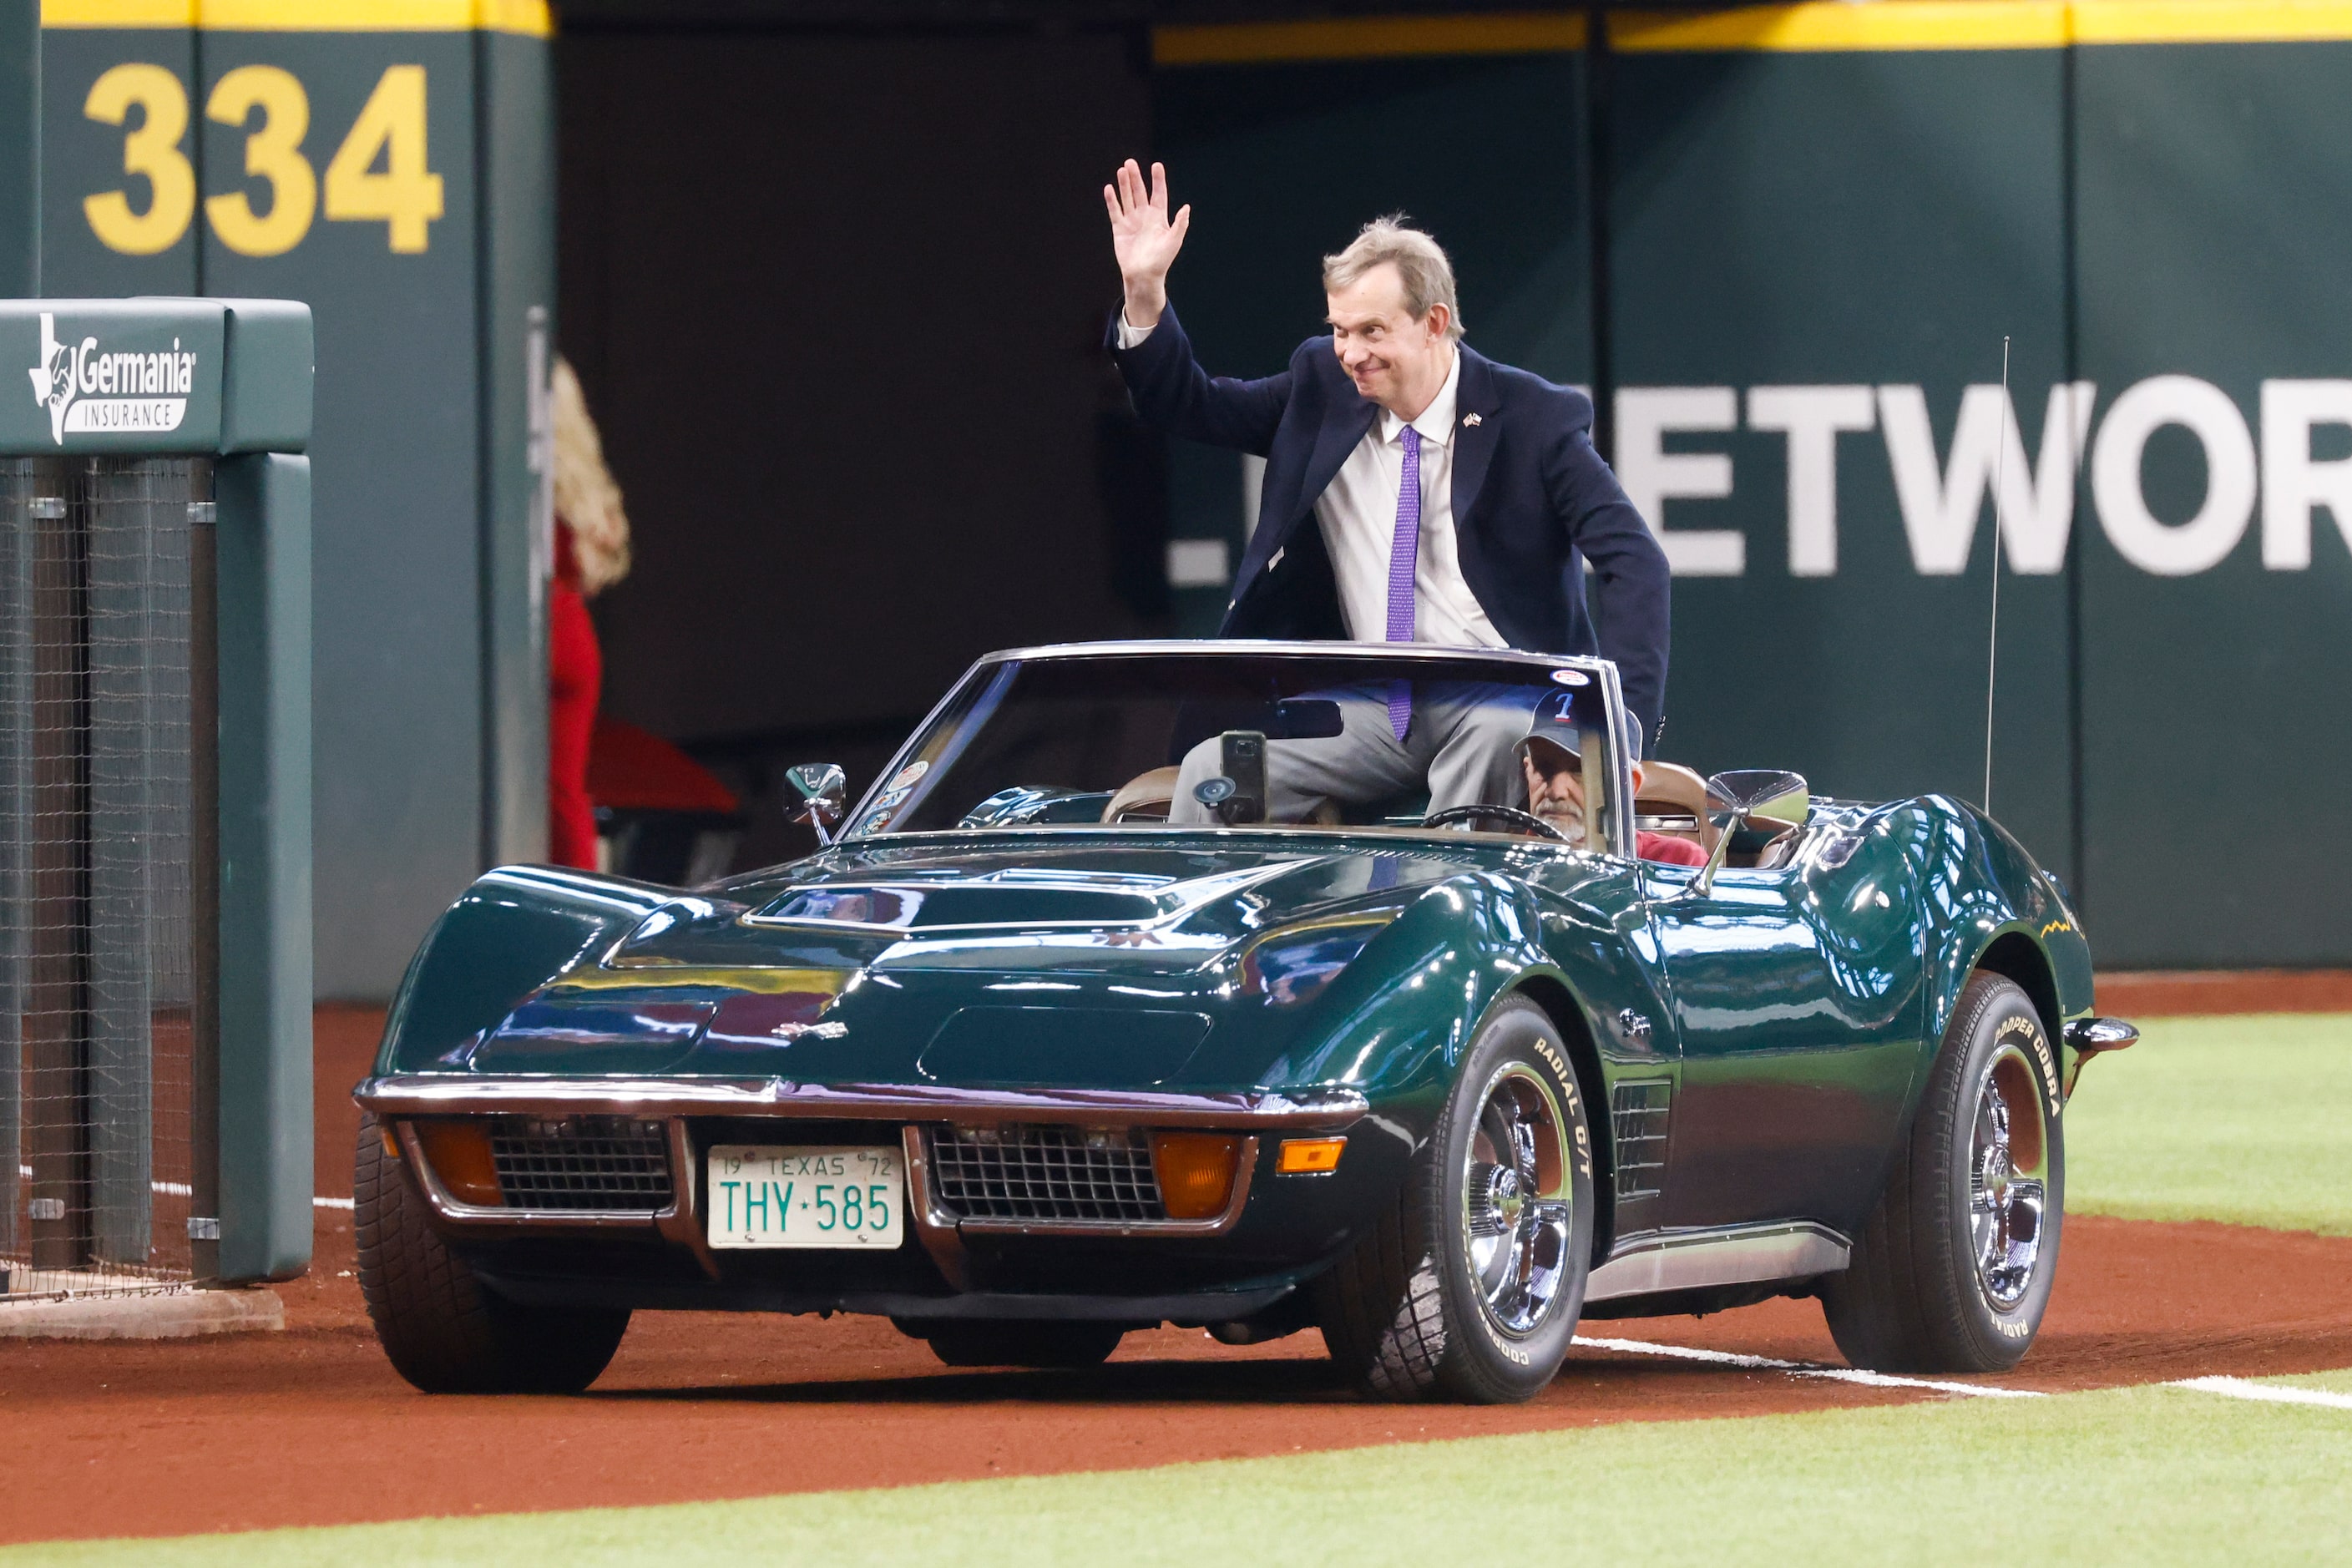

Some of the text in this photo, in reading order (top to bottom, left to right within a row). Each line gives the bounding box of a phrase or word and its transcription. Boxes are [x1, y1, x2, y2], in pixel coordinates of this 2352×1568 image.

[83, 63, 445, 255] 334
[84, 403, 171, 427] INSURANCE
[1580, 373, 2352, 577] ETWOR
[1534, 1036, 1591, 1180] RADIAL G/T
[1993, 1016, 2061, 1118] COOPER COBRA
[720, 1181, 889, 1232] THY 585
[722, 1156, 892, 1176] 19 TEXAS 72
